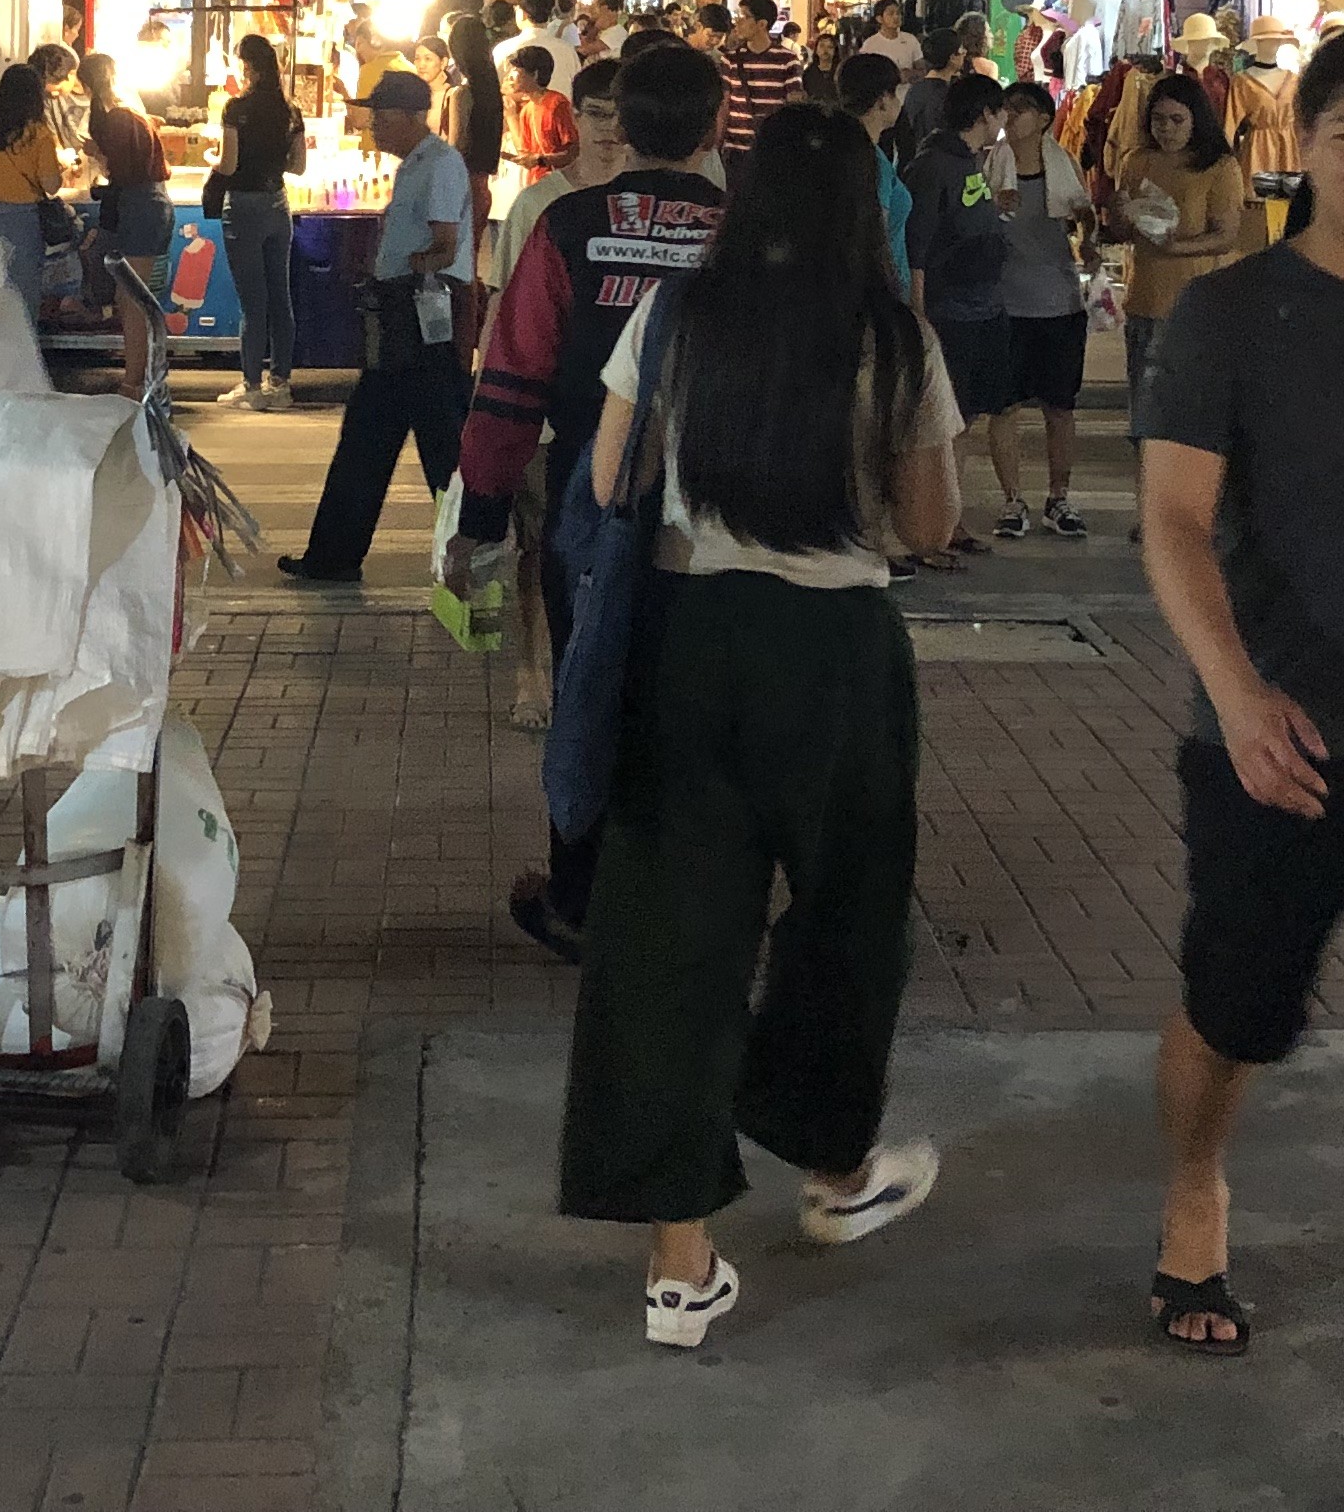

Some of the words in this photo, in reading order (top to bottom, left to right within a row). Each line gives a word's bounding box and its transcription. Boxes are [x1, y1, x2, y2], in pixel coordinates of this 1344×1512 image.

[654, 200, 725, 224] KFC
[651, 224, 717, 239] Deliver
[595, 244, 704, 264] www.kfc.c
